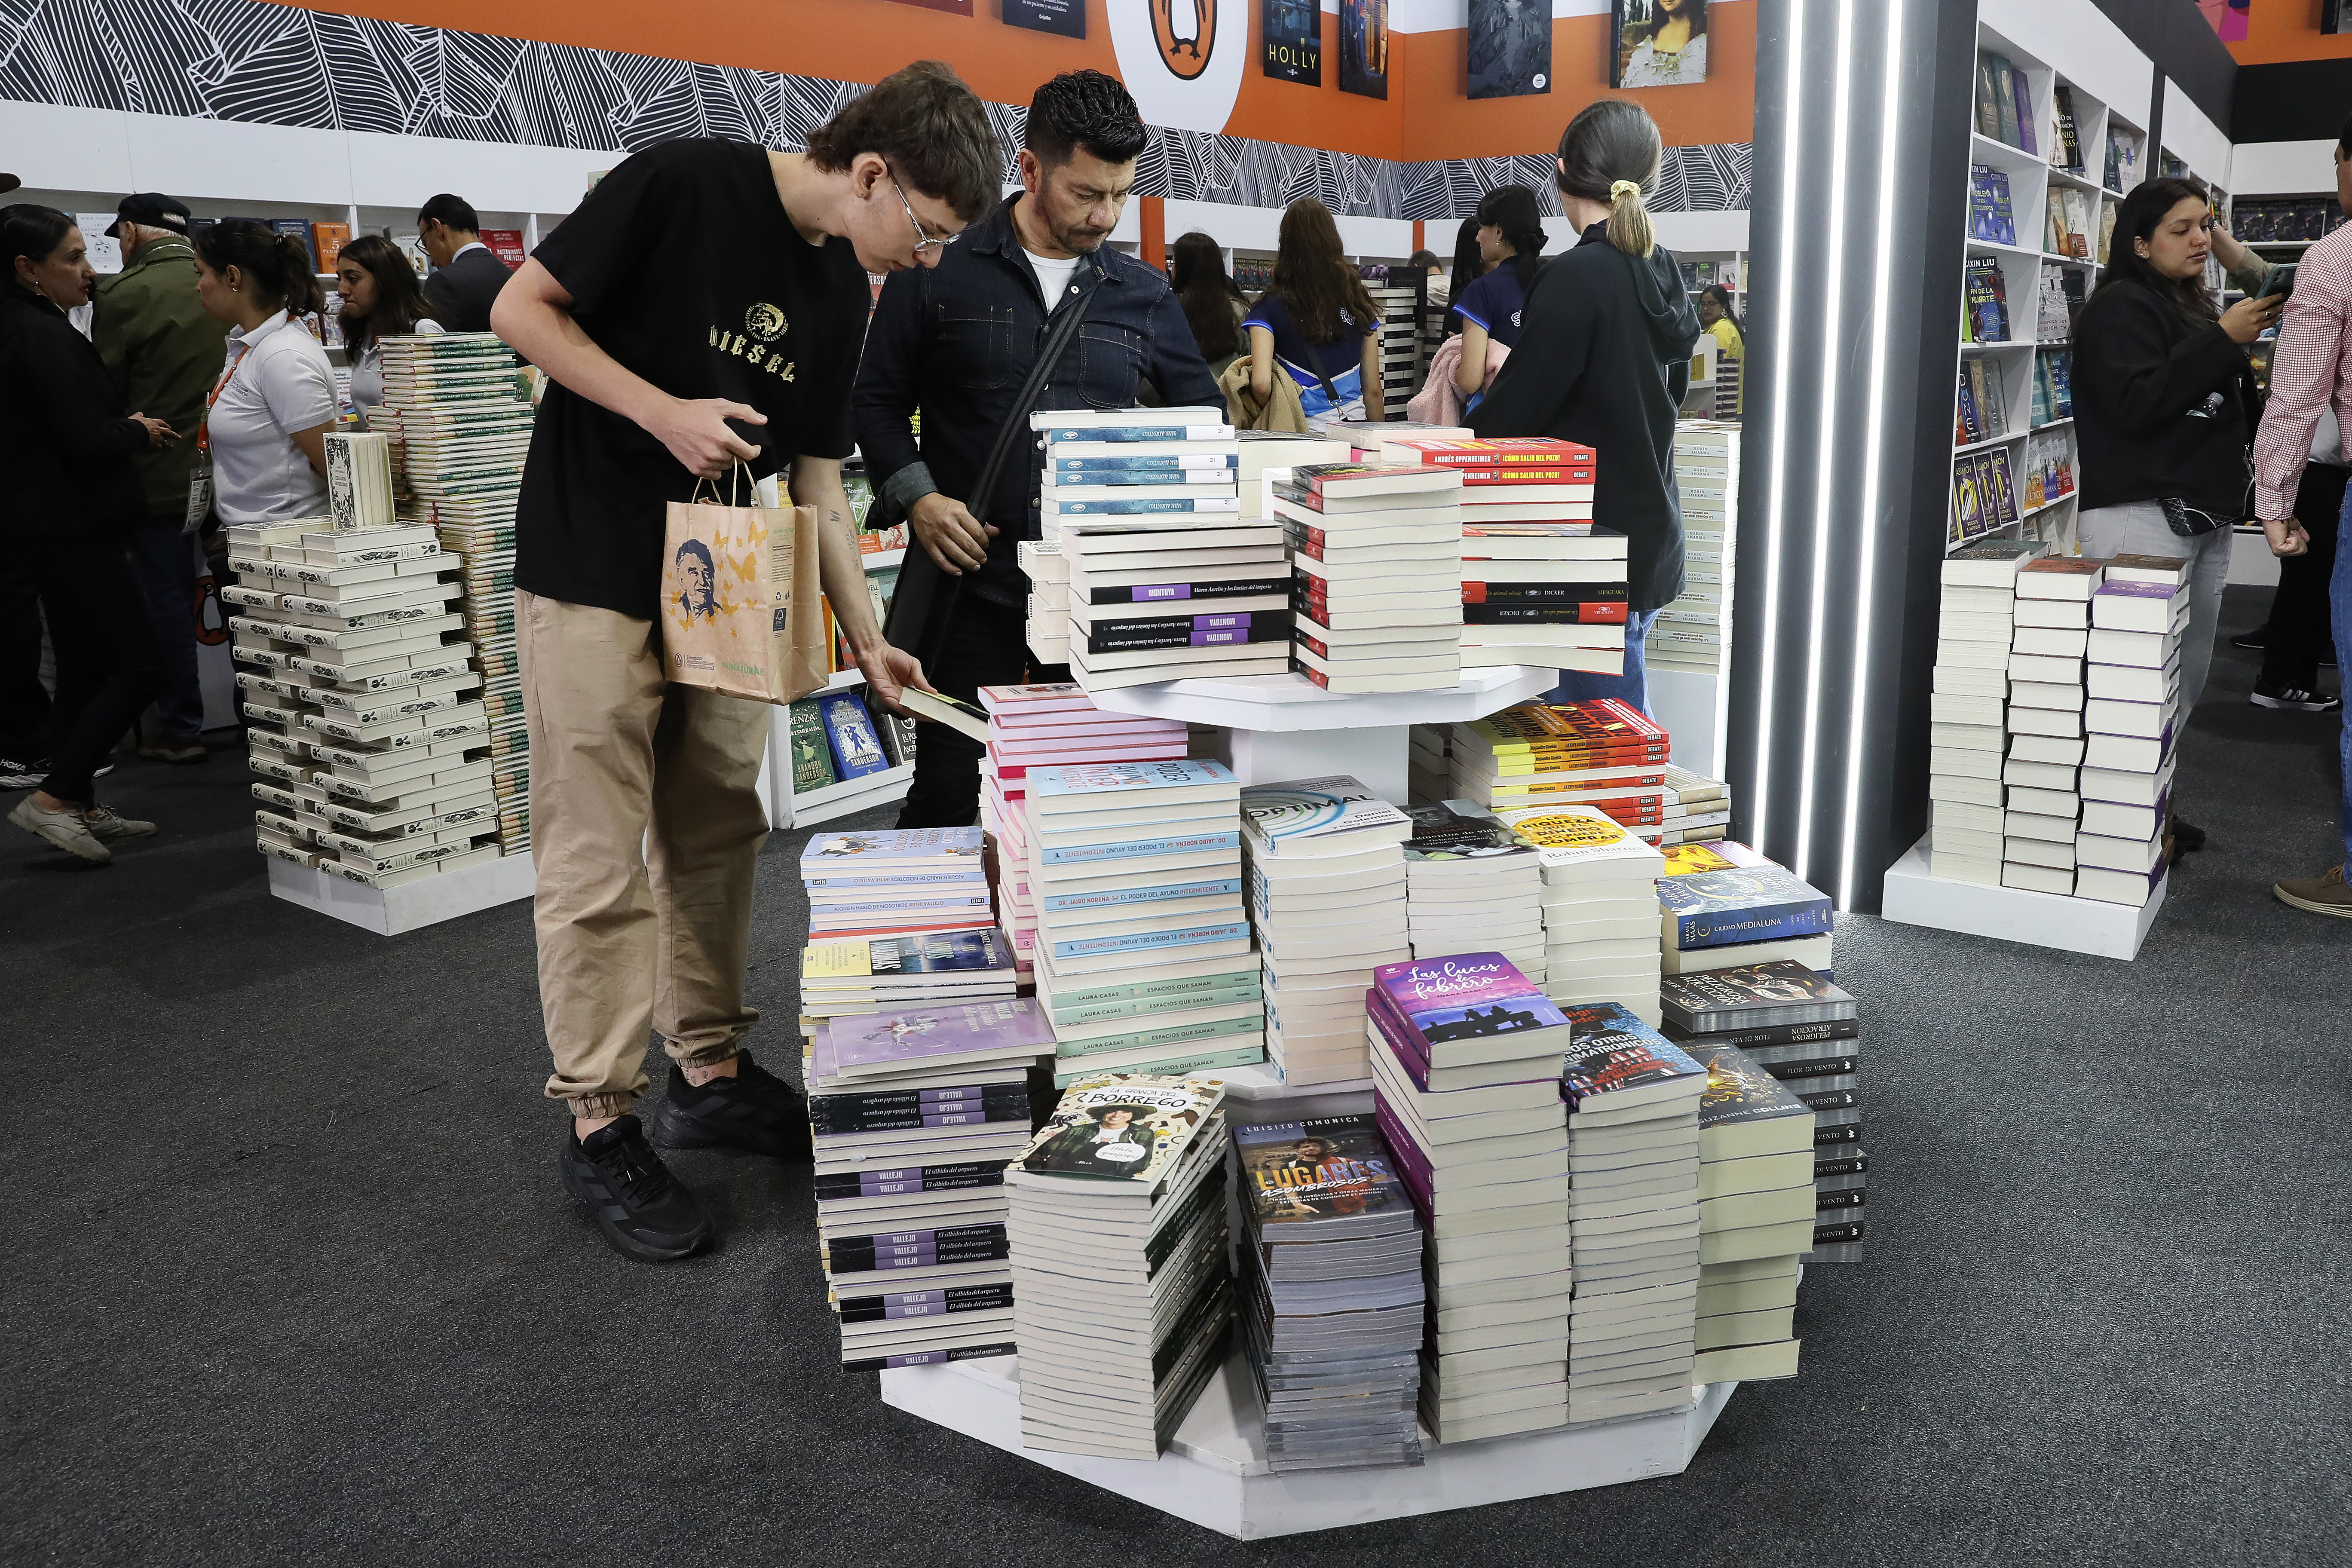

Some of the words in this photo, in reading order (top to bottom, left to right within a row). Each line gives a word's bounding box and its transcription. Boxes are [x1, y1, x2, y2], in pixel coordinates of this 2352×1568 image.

[1269, 44, 1316, 69] HOLLY
[1982, 258, 1995, 266] LIU
[1960, 374, 1974, 430] DUNE
[1434, 454, 1454, 463] ANDRÉS
[1956, 466, 1972, 476] ASIMOV
[1148, 588, 1175, 597] MONTOYA
[1210, 618, 1235, 626] MONTOYA
[790, 714, 818, 726] RENZA
[797, 760, 822, 773] BRANDON
[850, 754, 879, 767] SANDERSON
[796, 769, 827, 782] SANDERSON
[1248, 794, 1375, 818] OPTIMAL
[1344, 813, 1396, 824] Goleman
[1354, 810, 1391, 819] Daniel
[1522, 818, 1596, 830] RIQUEZA
[1536, 827, 1602, 836] DINERO
[1176, 839, 1198, 848] NOREÑA
[1537, 834, 1620, 846] COMPRAR
[1545, 848, 1578, 859] Robin
[1582, 845, 1644, 857] Sharma
[1180, 885, 1219, 895] INTERMITENTE
[1736, 918, 1782, 930] MEDIALUNA
[1408, 967, 1441, 982] Las
[1444, 962, 1500, 977] luces
[1147, 984, 1175, 992] ESPACIOS
[1410, 975, 1510, 1000] febrero
[1695, 974, 1750, 1004] PELIGROSA
[1591, 1033, 1638, 1047] OTROS
[1792, 1032, 1830, 1041] PELIGROSA
[939, 1090, 963, 1099] VALLEJO
[1088, 1093, 1187, 1108] BORREGO
[1698, 1110, 1751, 1124] SUZANNE
[1752, 1104, 1802, 1113] COLLINS
[1247, 1123, 1293, 1132] LUISITO
[1299, 1117, 1360, 1127] COMUNICA
[879, 1171, 903, 1179] VALLEJO
[1256, 1160, 1384, 1191] LUGARES
[1261, 1177, 1368, 1197] ASOMBROSOS
[892, 1234, 916, 1243] VALLEJO
